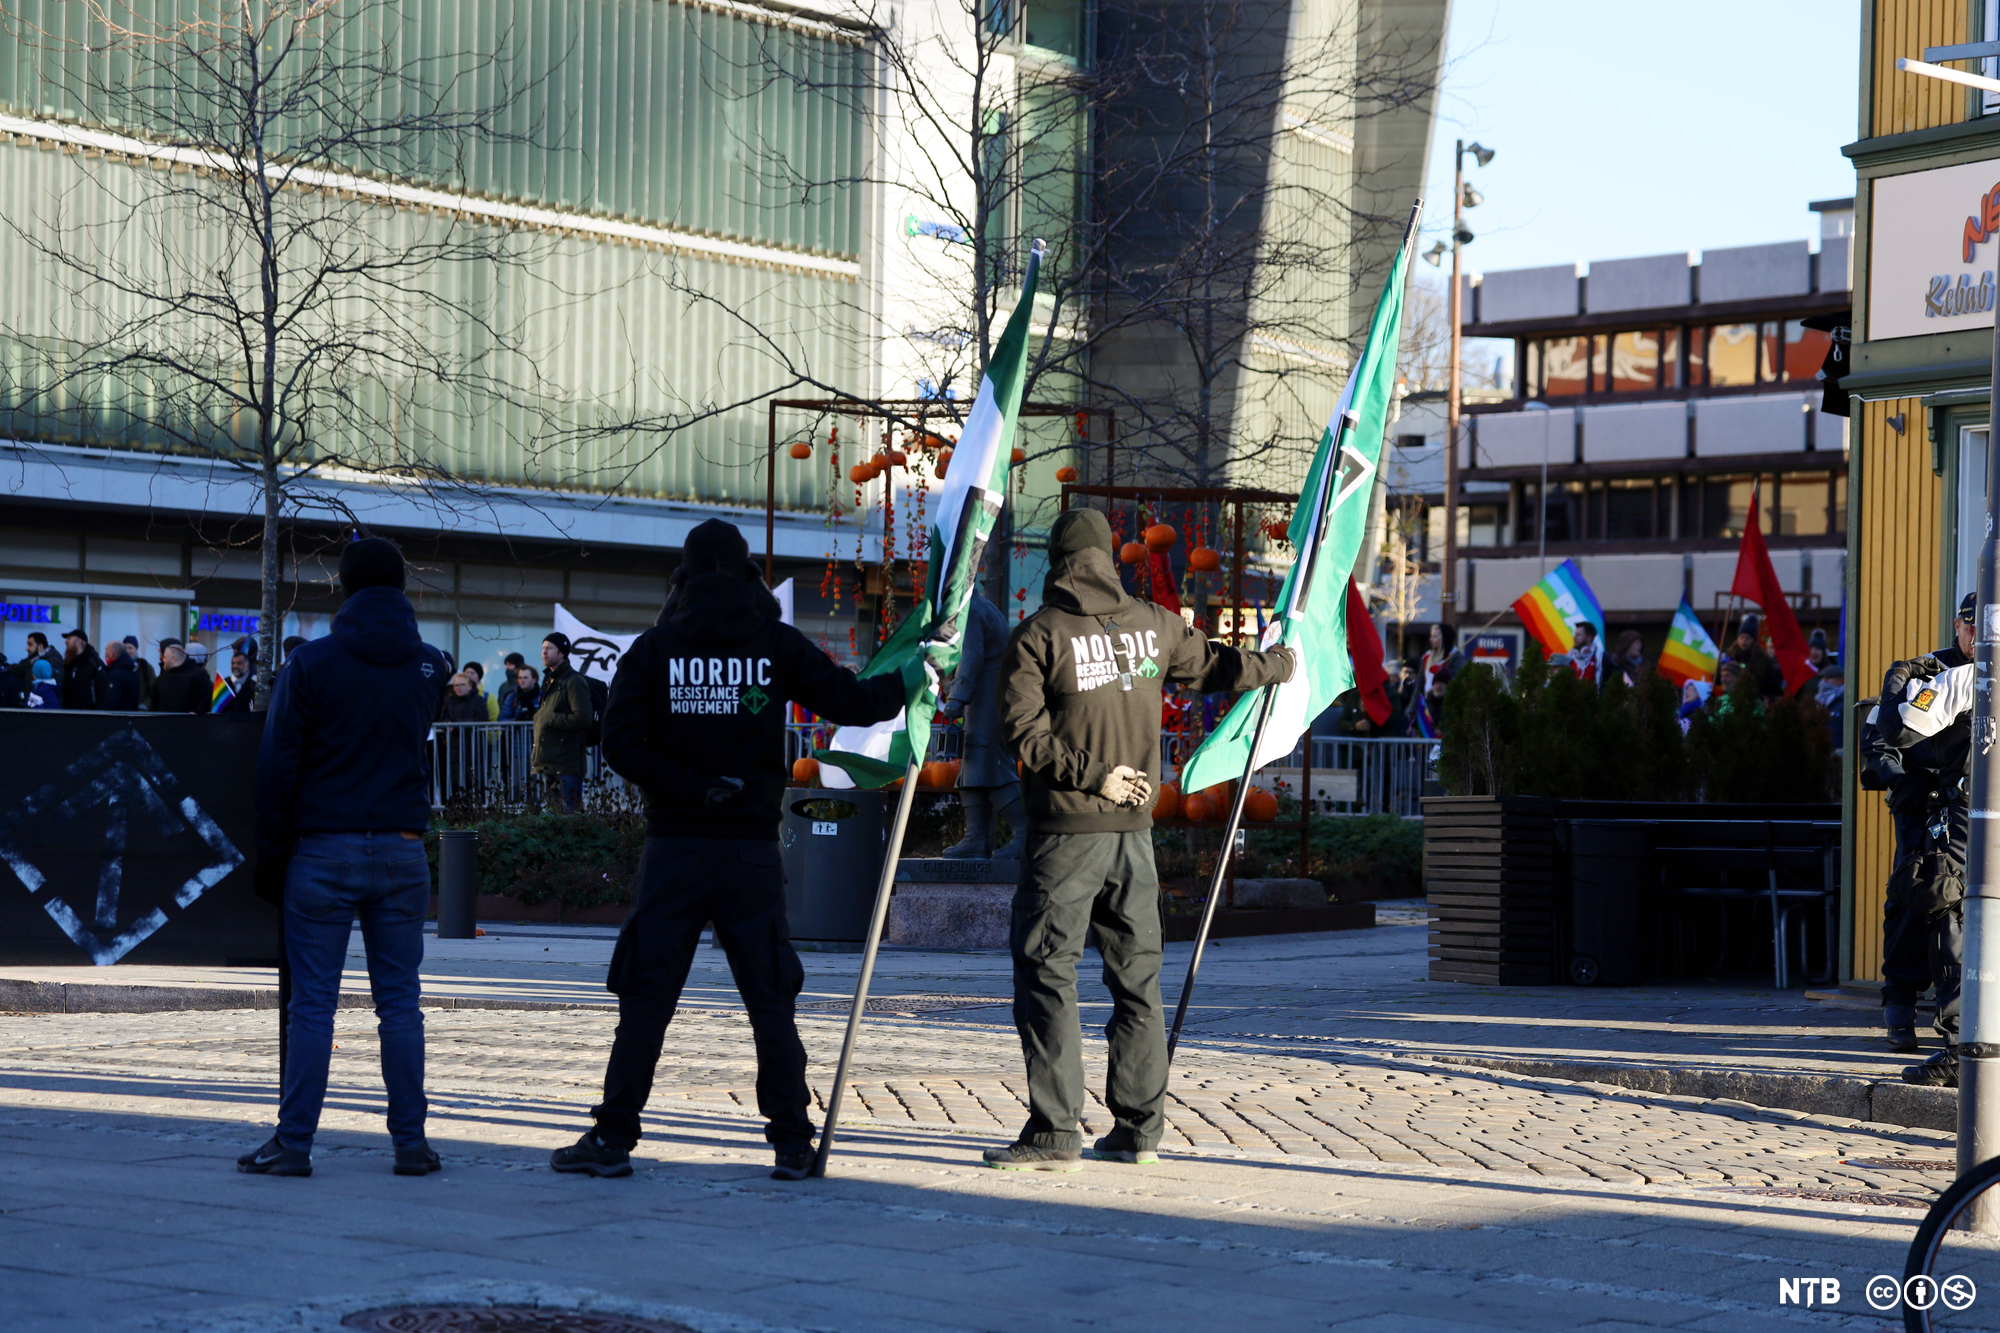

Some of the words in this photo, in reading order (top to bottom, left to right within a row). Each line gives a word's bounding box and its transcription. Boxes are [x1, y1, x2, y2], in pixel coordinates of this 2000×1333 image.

[1925, 270, 1996, 318] Kebab
[0, 602, 51, 624] POTEK
[198, 613, 260, 635] APOTEK
[1478, 637, 1505, 650] RING
[669, 657, 771, 686] NORDIC
[1076, 659, 1137, 678] RESISTAE
[669, 686, 739, 700] RESISTANCE
[671, 700, 740, 714] MOVEMENT
